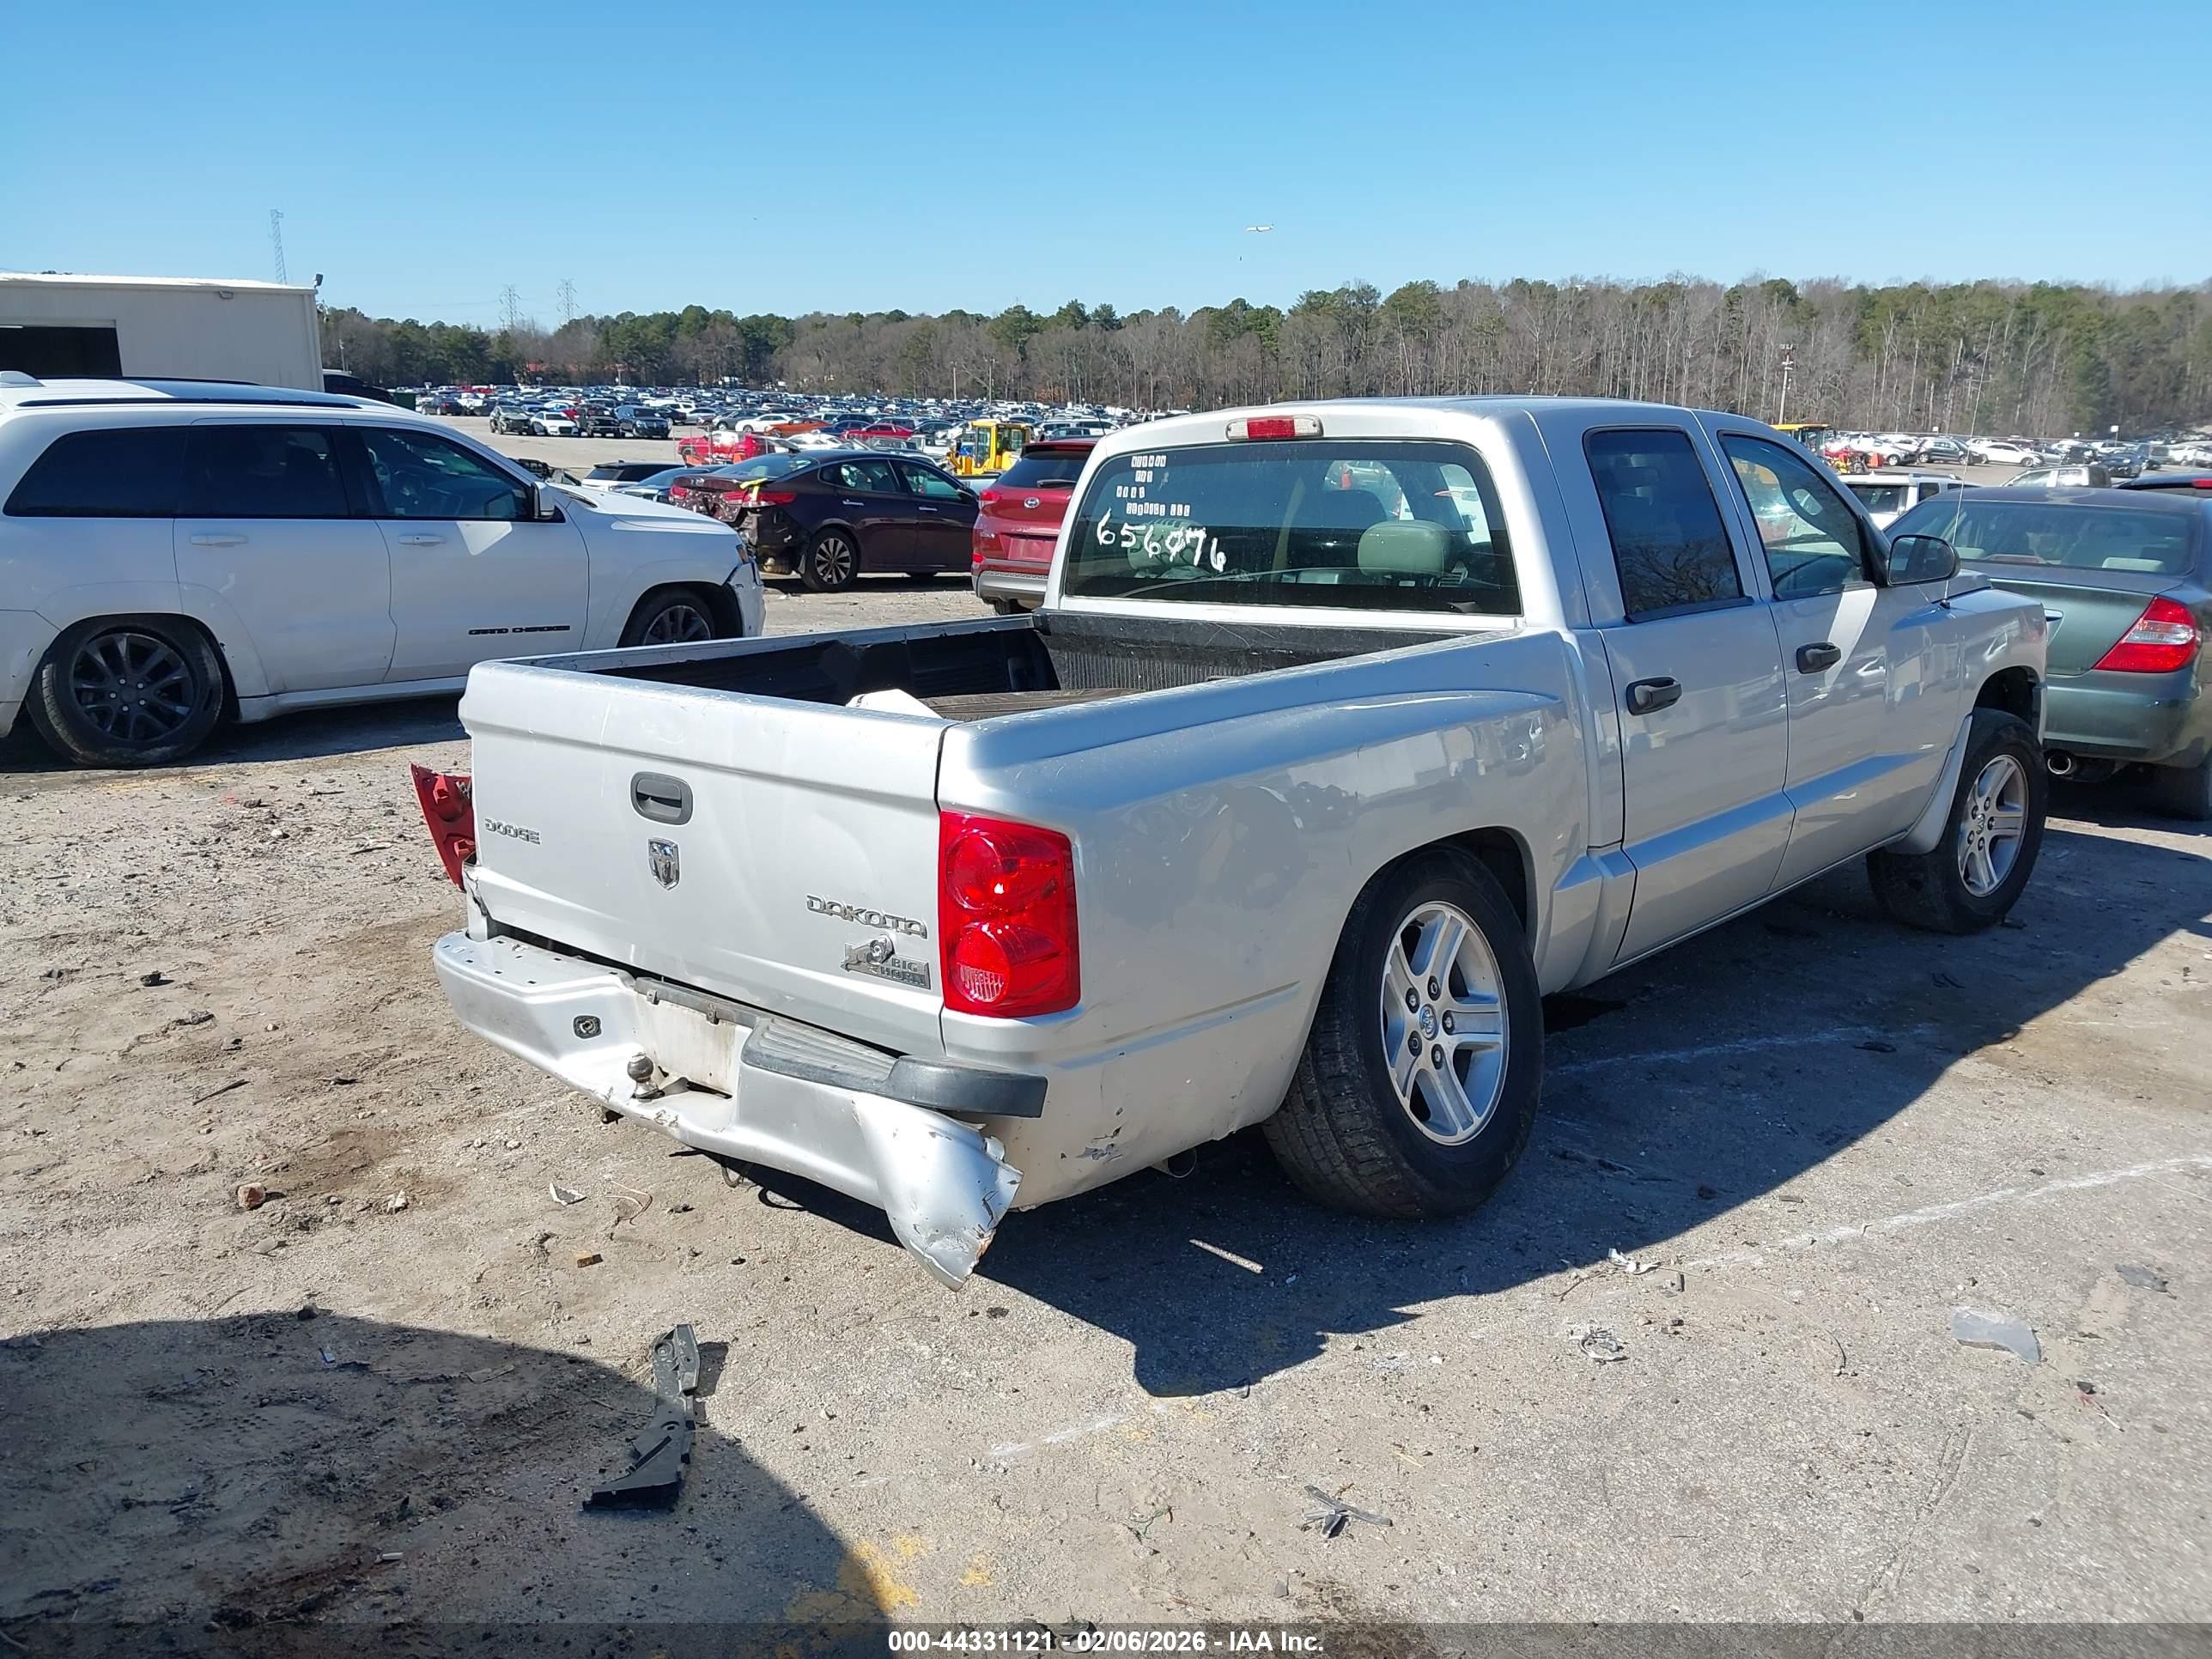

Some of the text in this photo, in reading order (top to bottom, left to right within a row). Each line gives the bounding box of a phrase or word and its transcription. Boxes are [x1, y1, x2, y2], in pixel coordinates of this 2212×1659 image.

[485, 818, 540, 845] DODGE
[806, 895, 927, 939] DAKOTA
[879, 966, 926, 986] HORN
[891, 957, 918, 972] BIG
